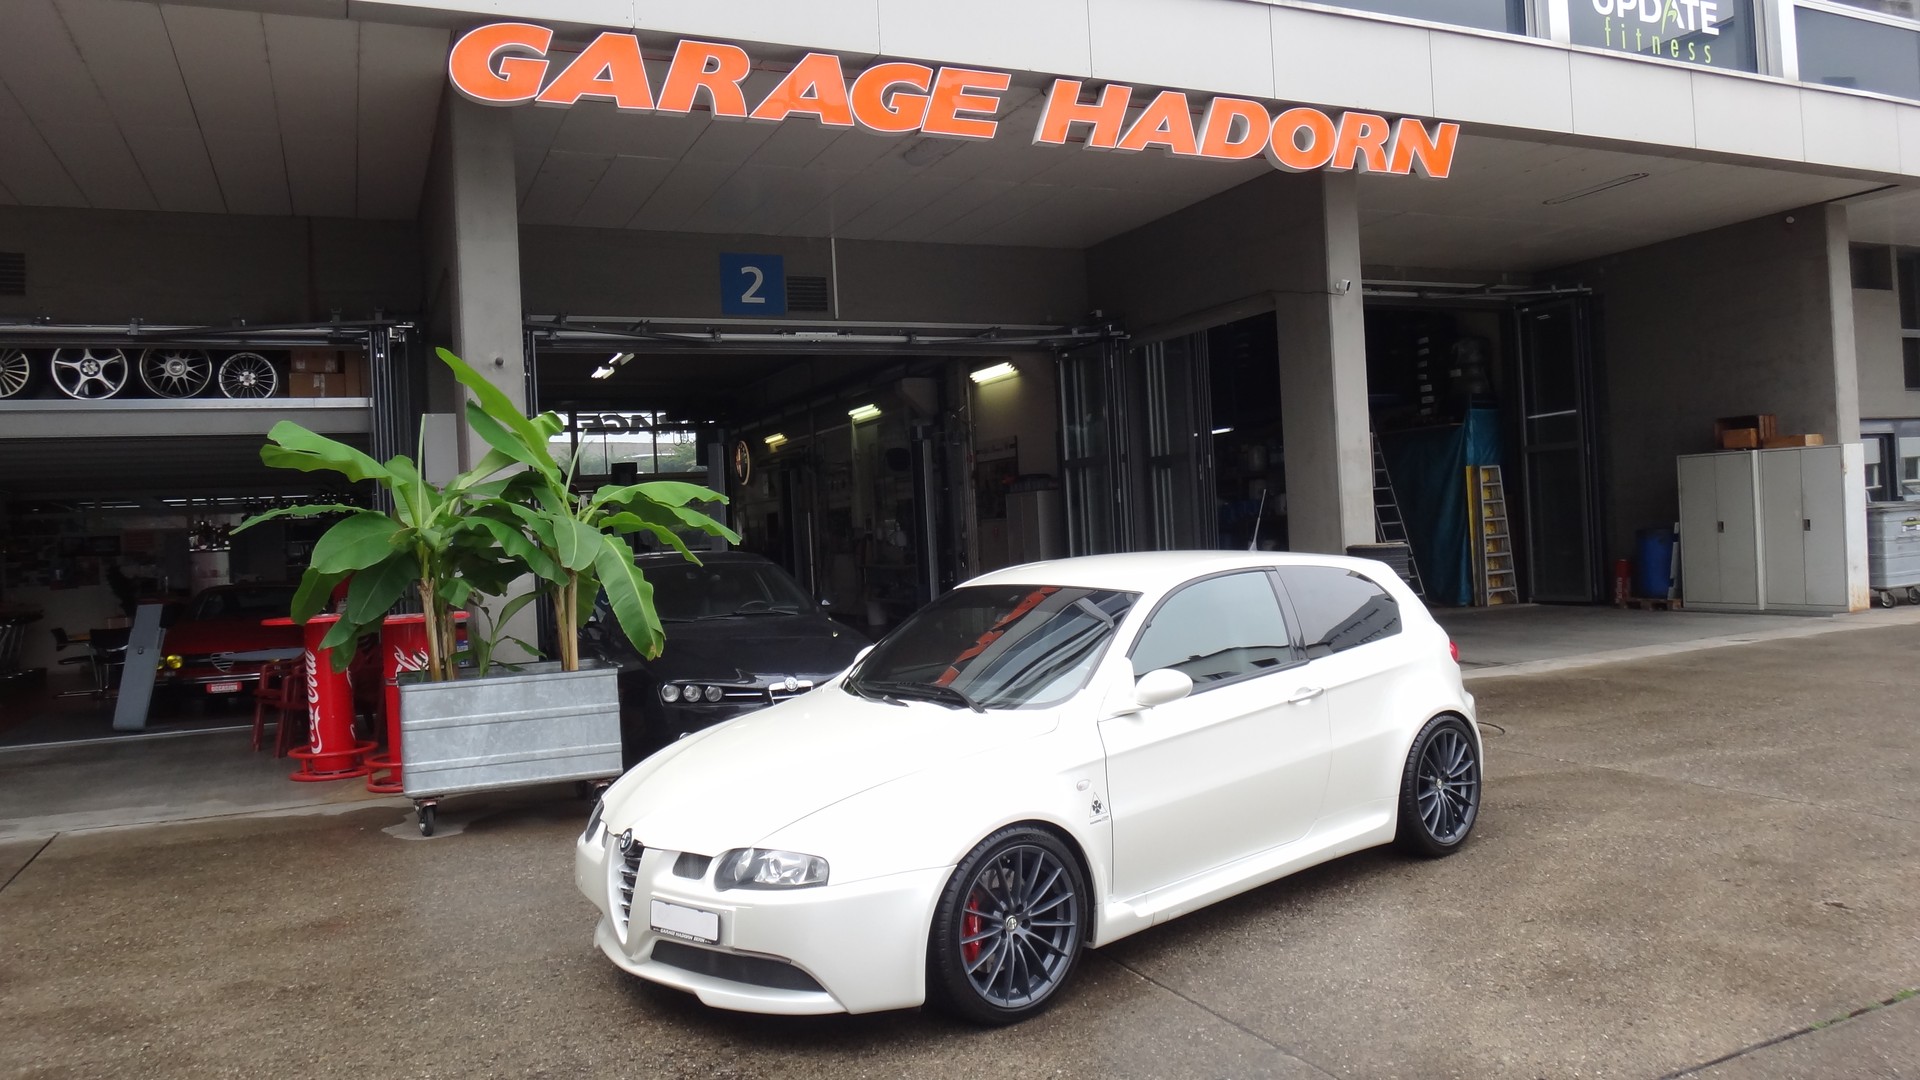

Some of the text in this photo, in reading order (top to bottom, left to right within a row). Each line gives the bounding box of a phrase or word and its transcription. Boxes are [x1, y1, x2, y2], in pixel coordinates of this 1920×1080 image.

[1604, 17, 1712, 64] fitness
[449, 22, 1460, 179] GARAGE HADORN
[741, 266, 766, 303] 2
